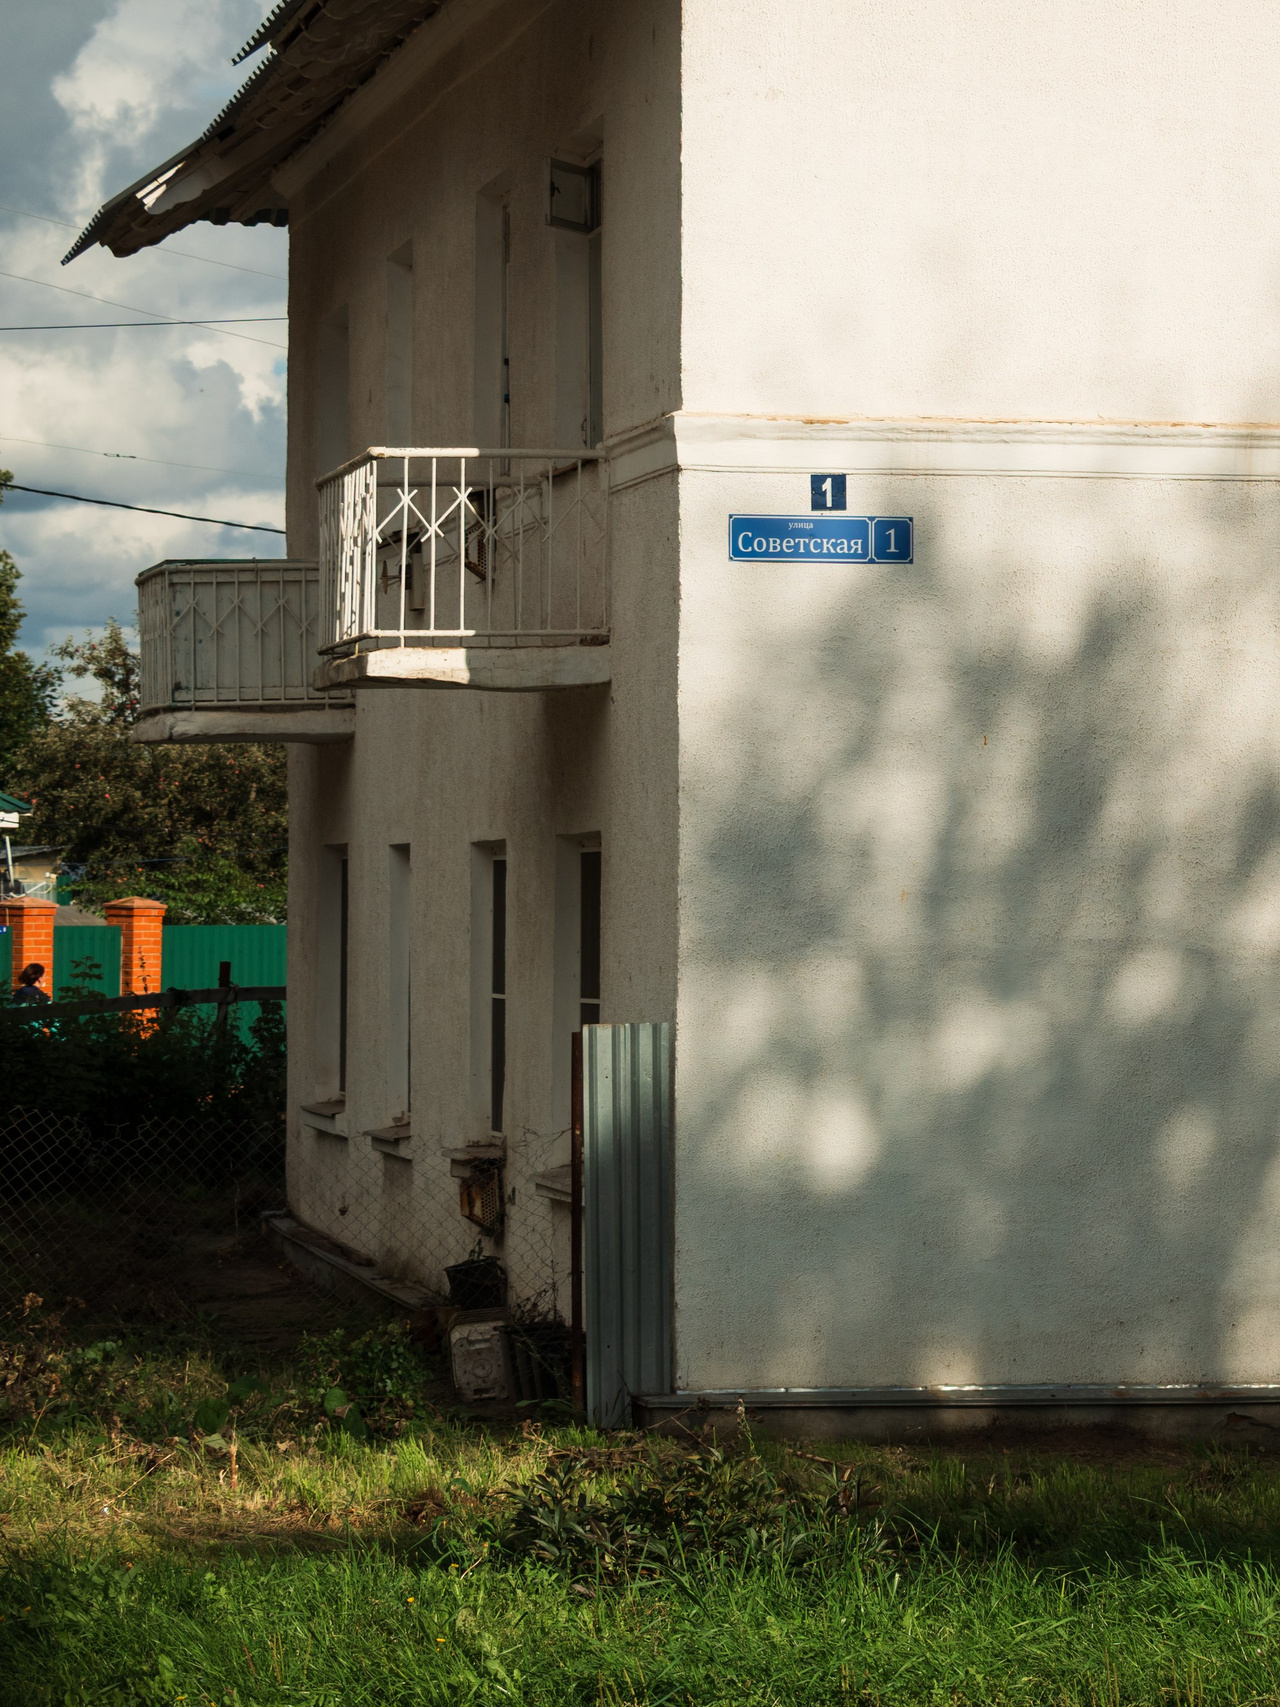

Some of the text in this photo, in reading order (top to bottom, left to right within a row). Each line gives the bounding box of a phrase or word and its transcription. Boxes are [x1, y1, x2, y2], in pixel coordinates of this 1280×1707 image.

[822, 477, 832, 507] 1
[738, 529, 899, 553] Советская 1
